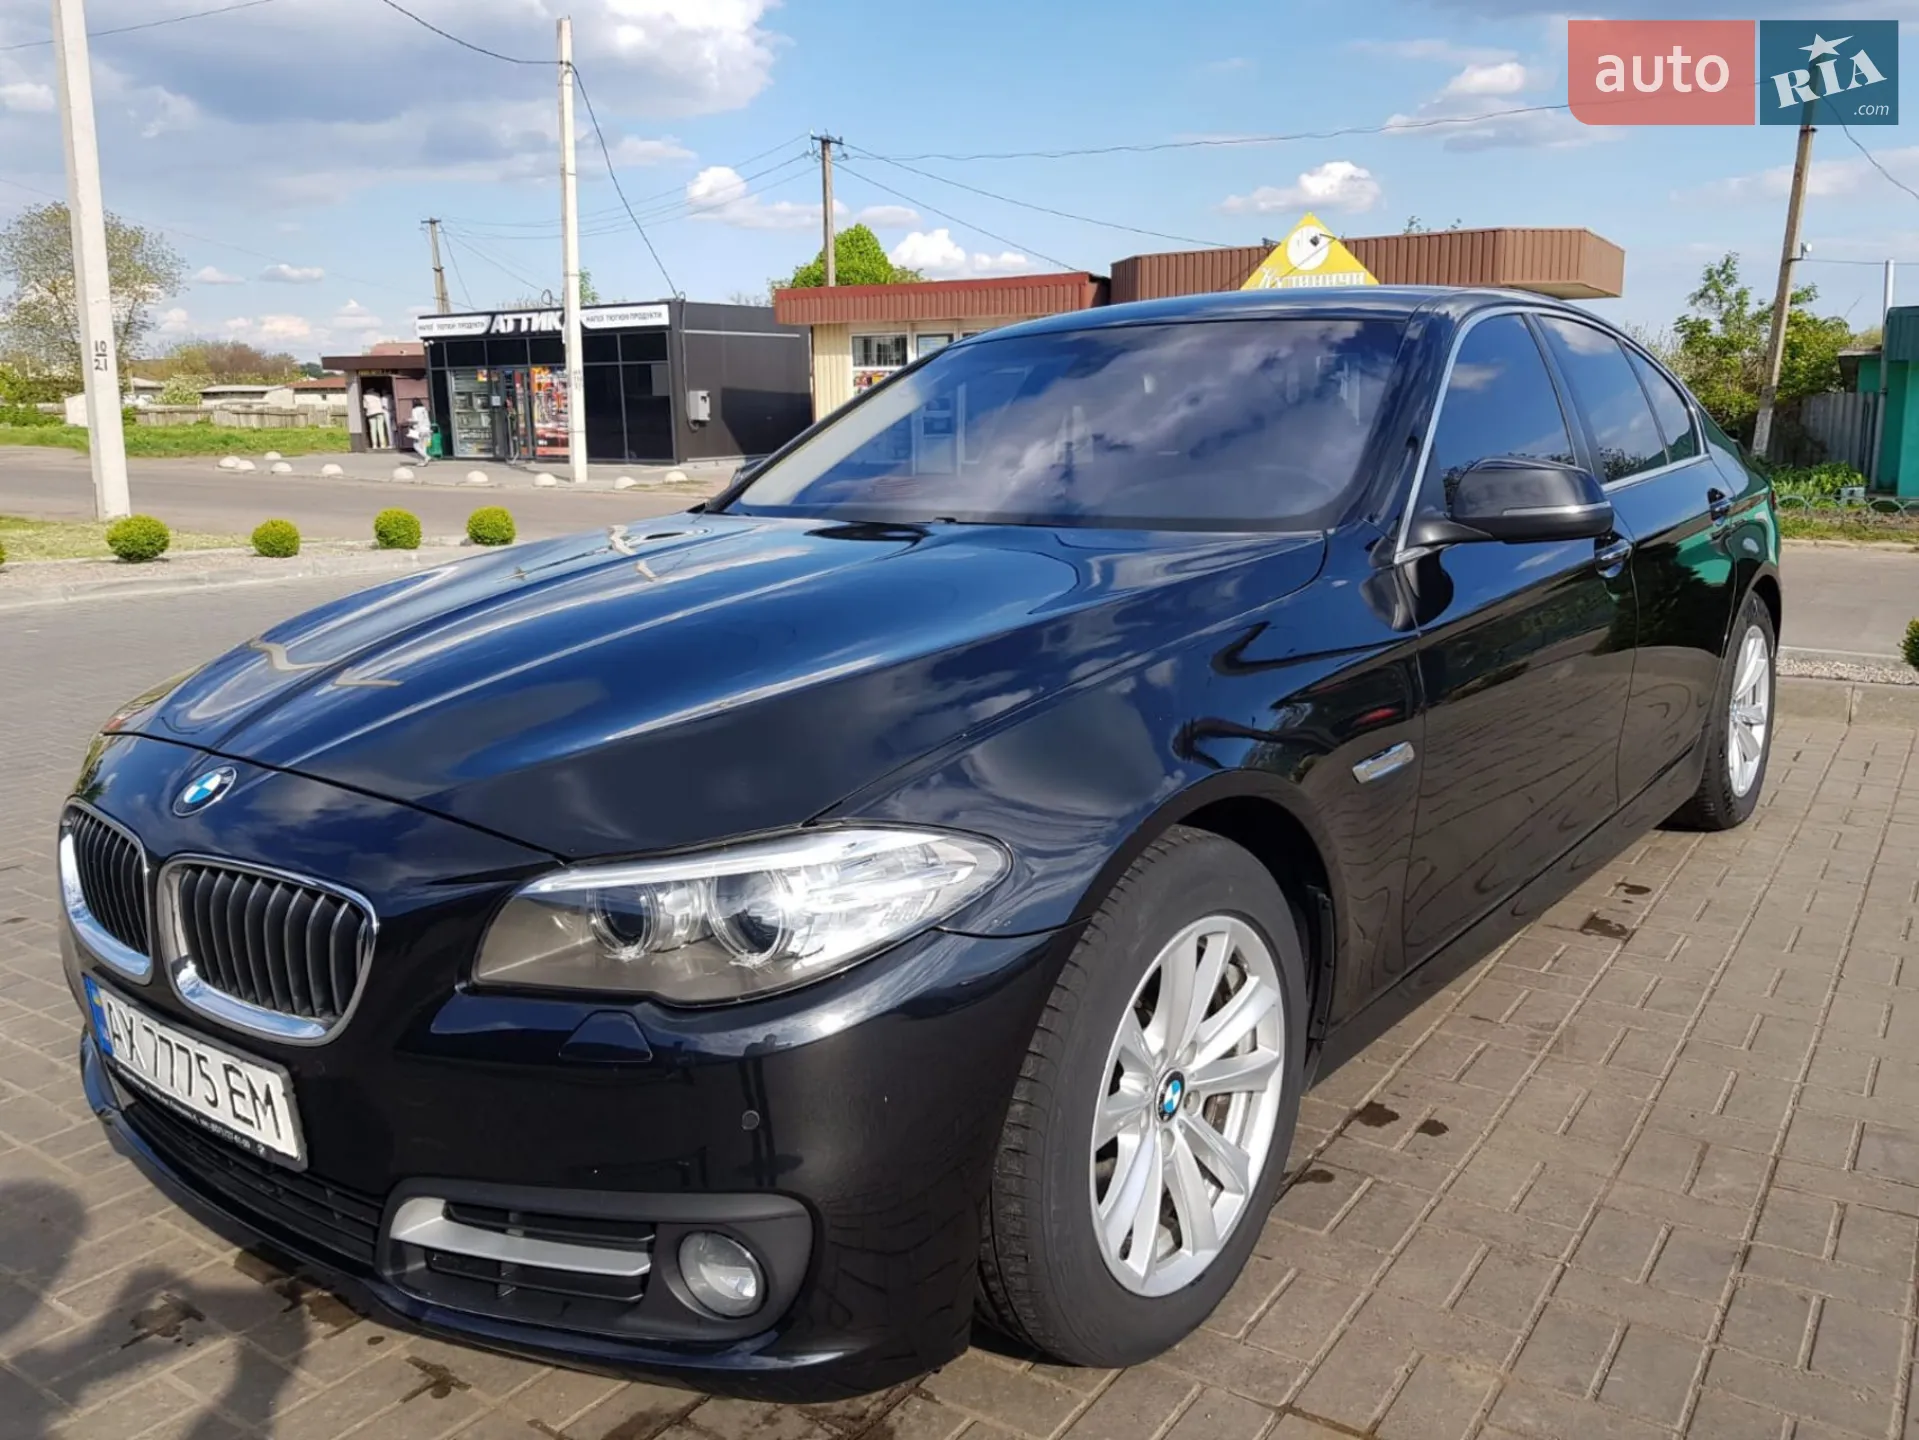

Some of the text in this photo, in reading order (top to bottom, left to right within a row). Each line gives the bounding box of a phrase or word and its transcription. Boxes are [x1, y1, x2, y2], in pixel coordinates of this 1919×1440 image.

[489, 310, 565, 334] АТТИК
[94, 340, 107, 352] 10
[94, 358, 108, 371] 21
[107, 1001, 146, 1070] AX
[142, 1023, 220, 1109] 7775
[221, 1062, 282, 1141] EM
